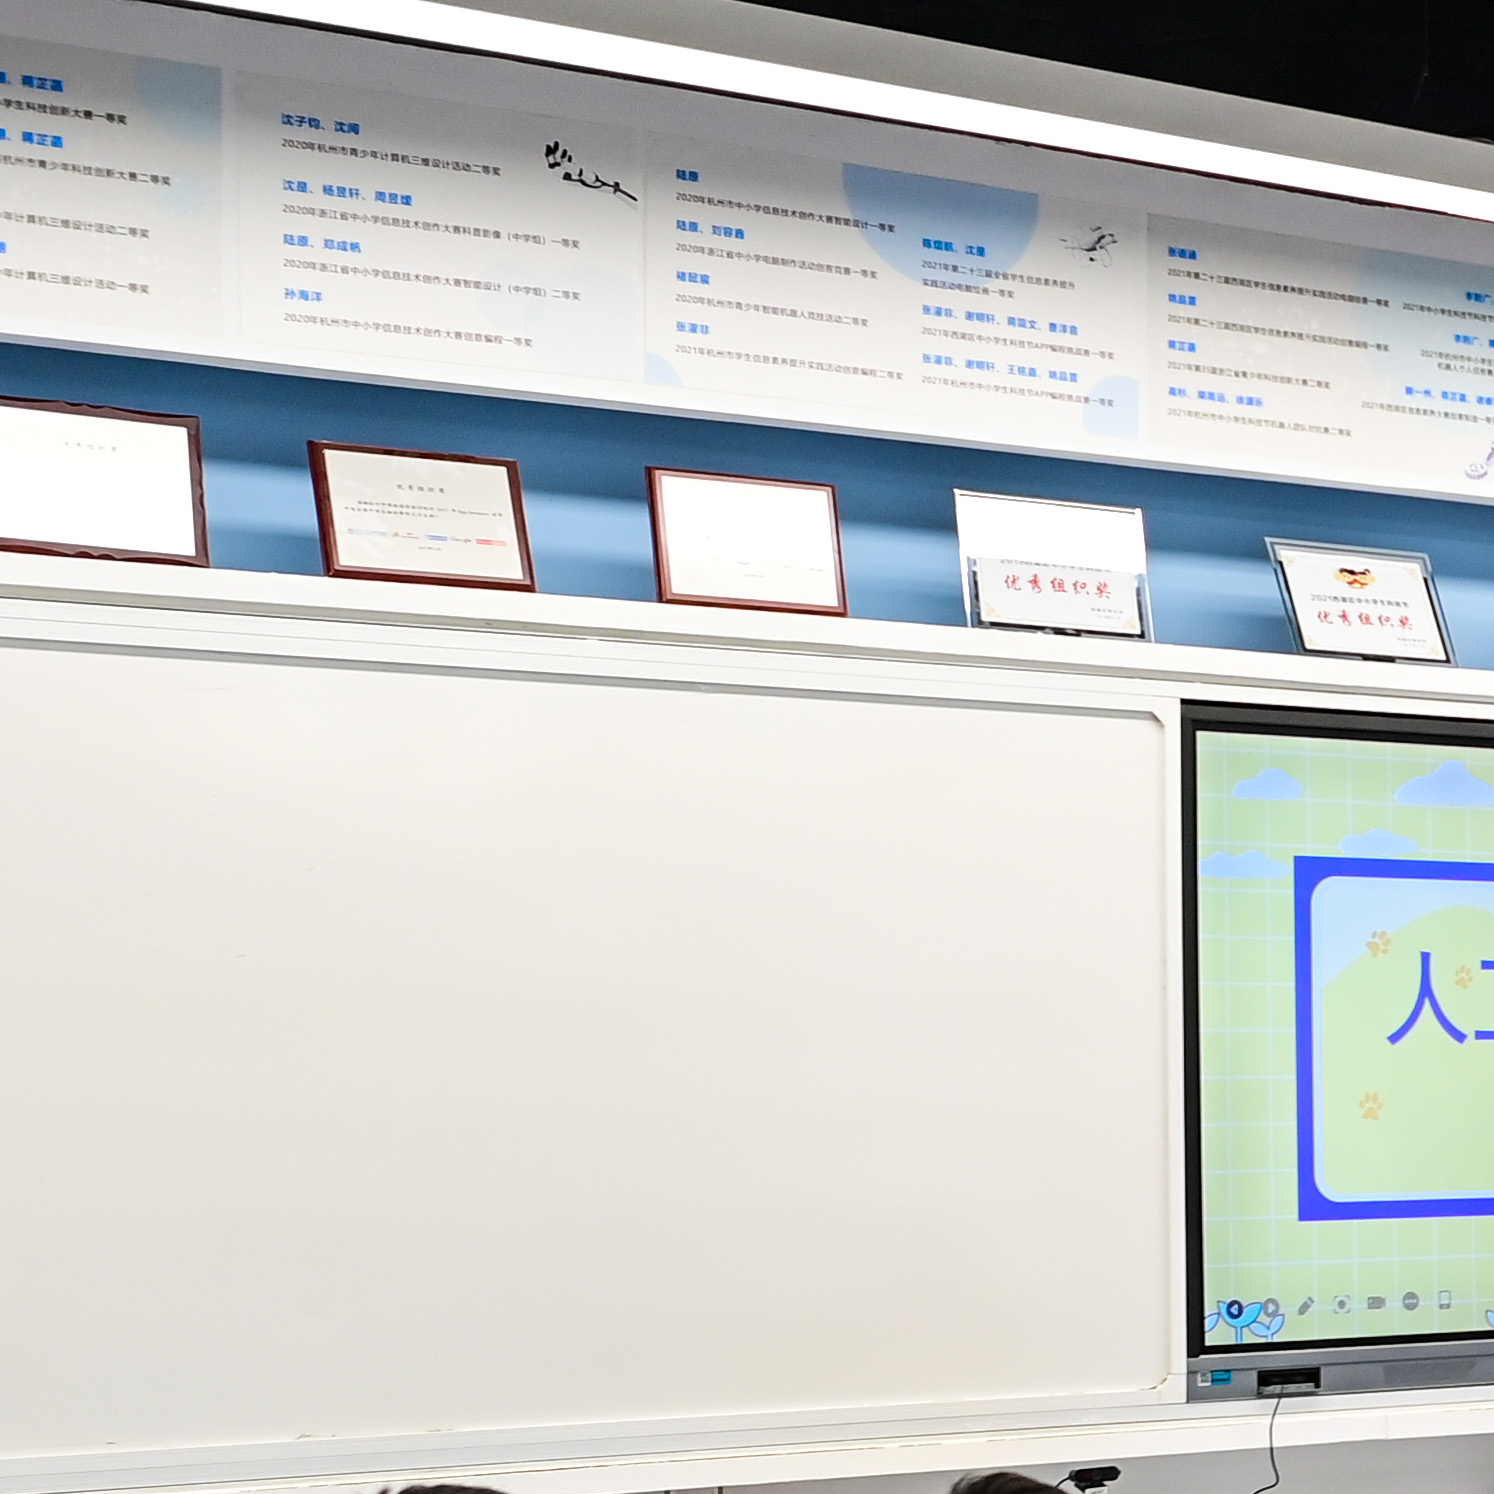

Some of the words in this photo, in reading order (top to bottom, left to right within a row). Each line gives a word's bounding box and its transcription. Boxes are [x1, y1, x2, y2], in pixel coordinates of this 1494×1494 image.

[1004, 573, 1112, 600] 优秀组织奖
